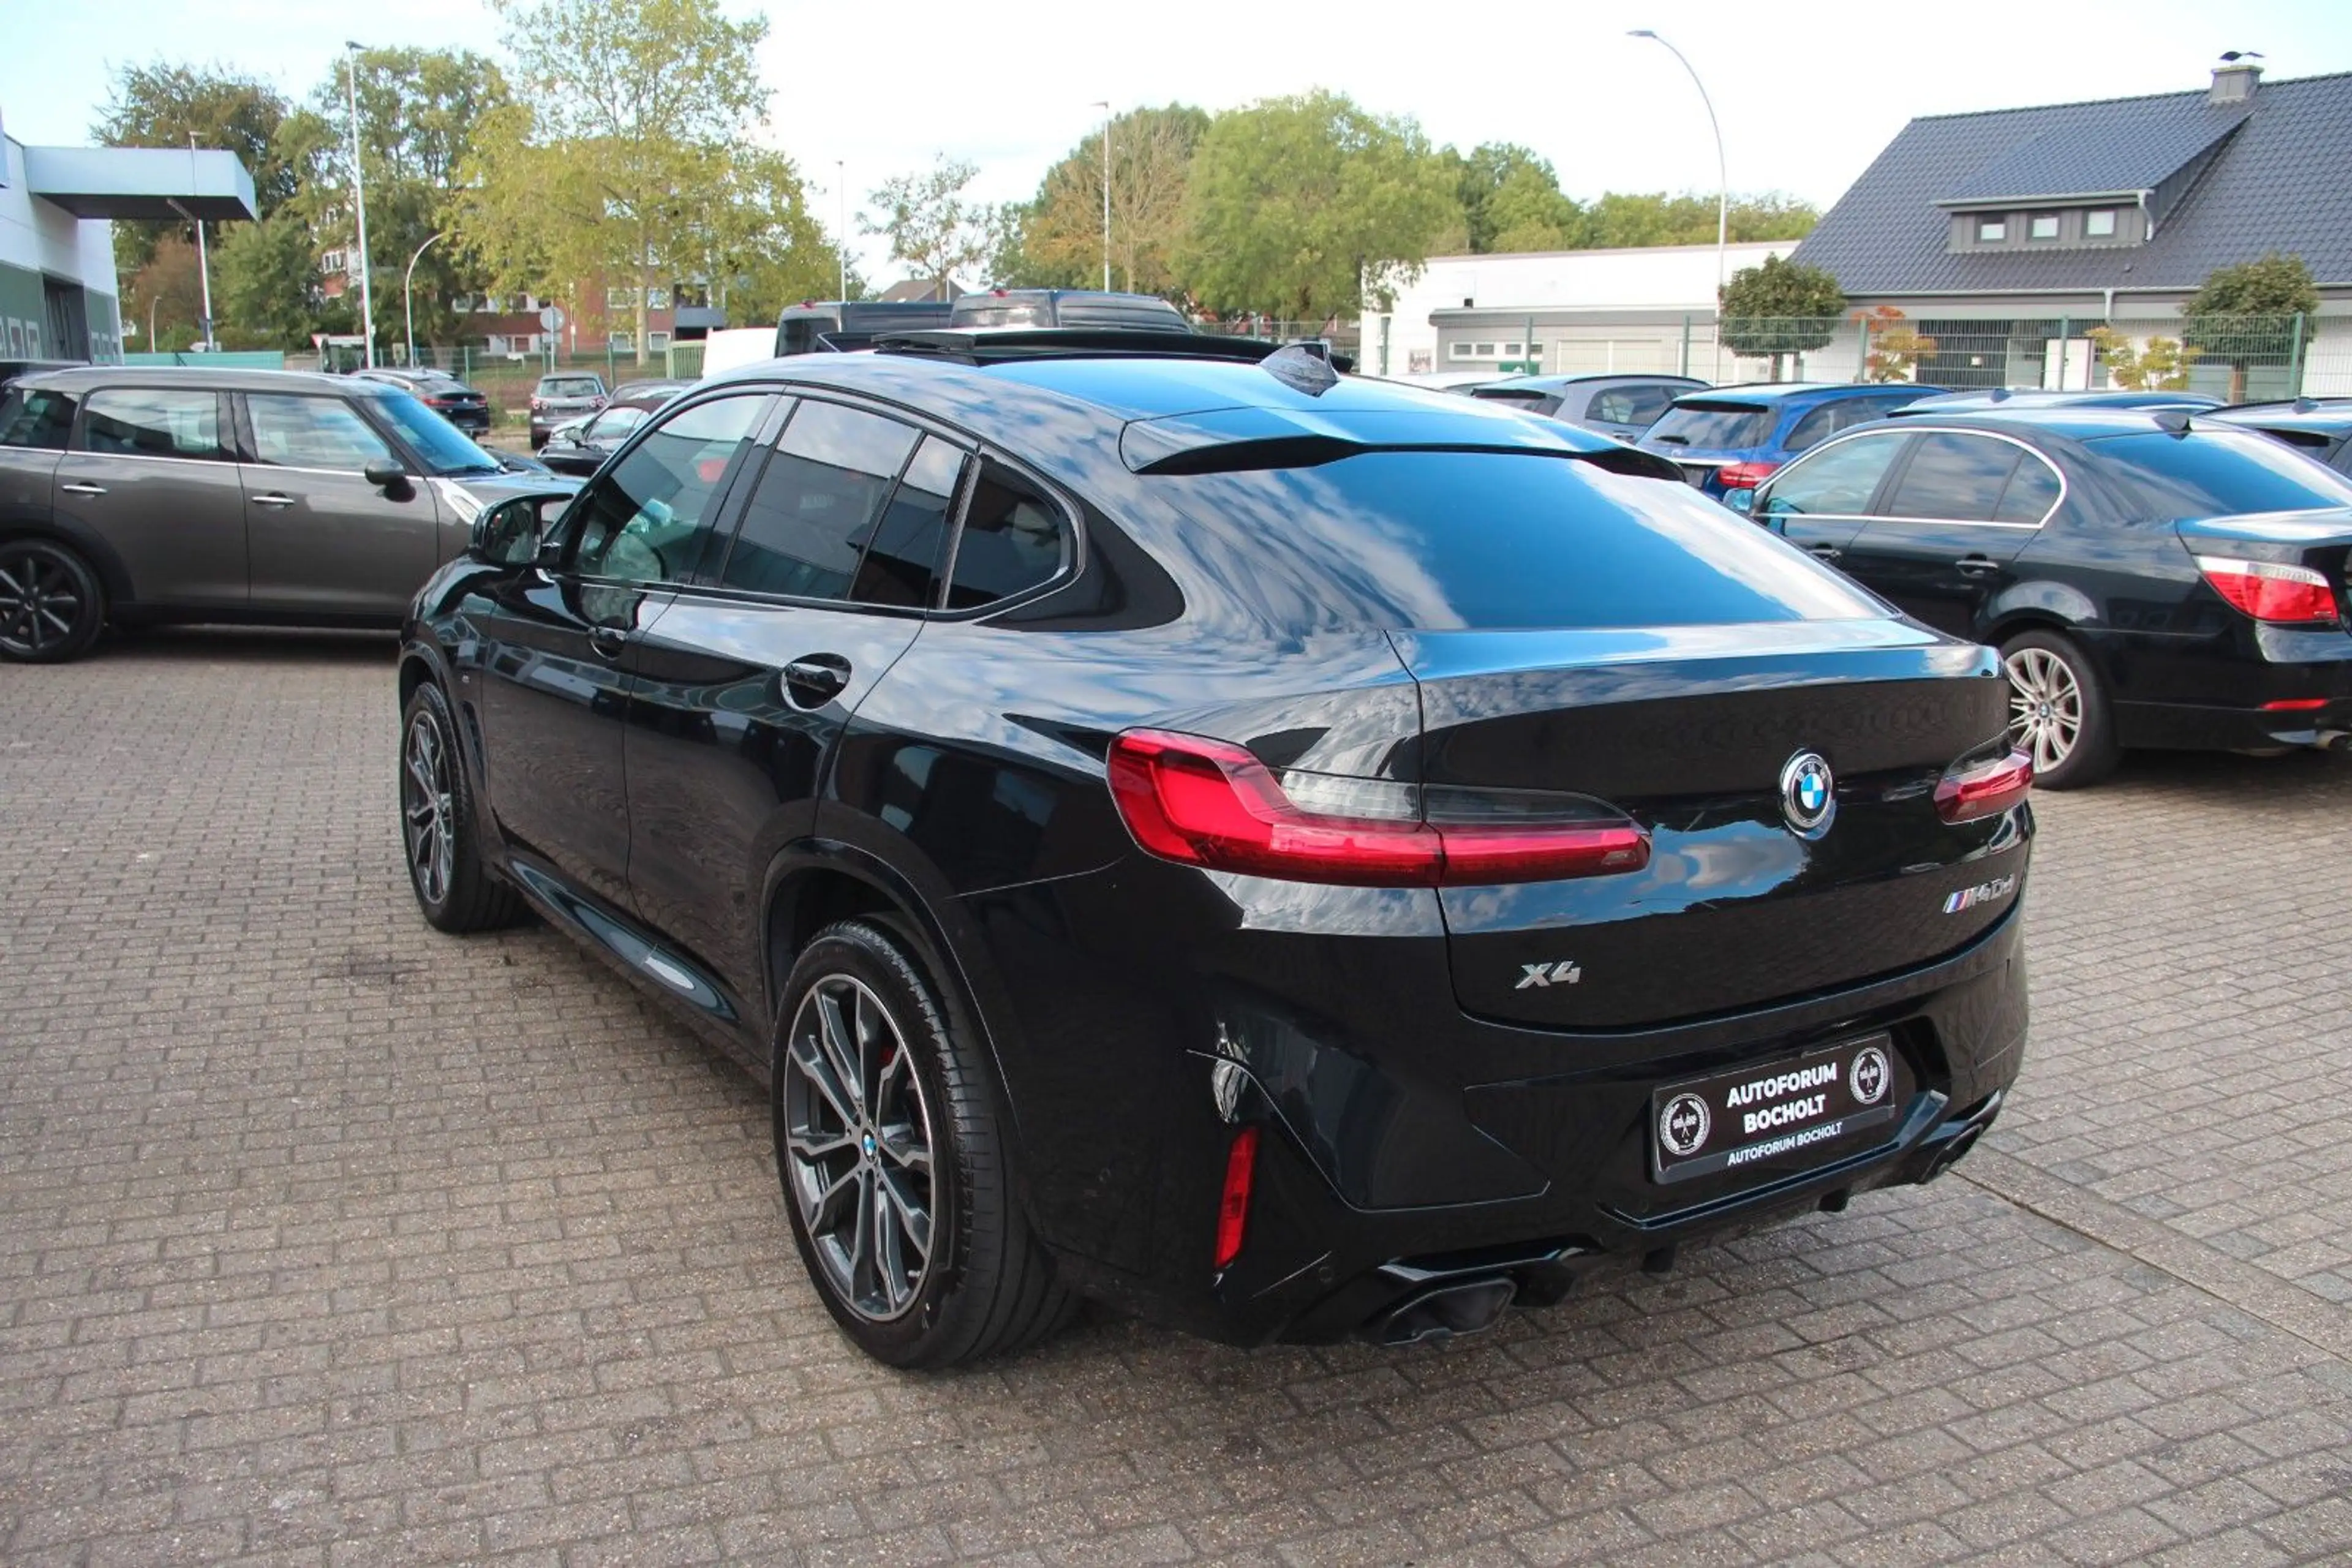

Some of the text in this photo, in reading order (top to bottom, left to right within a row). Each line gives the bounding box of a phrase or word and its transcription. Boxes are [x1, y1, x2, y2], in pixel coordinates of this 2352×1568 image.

[1514, 960, 1581, 989] X4
[1726, 1062, 1837, 1108] AUTOFORUM
[1743, 1093, 1826, 1133] BOCHOLT
[1727, 1121, 1843, 1166] AUTOFORUM BOCHOLT
